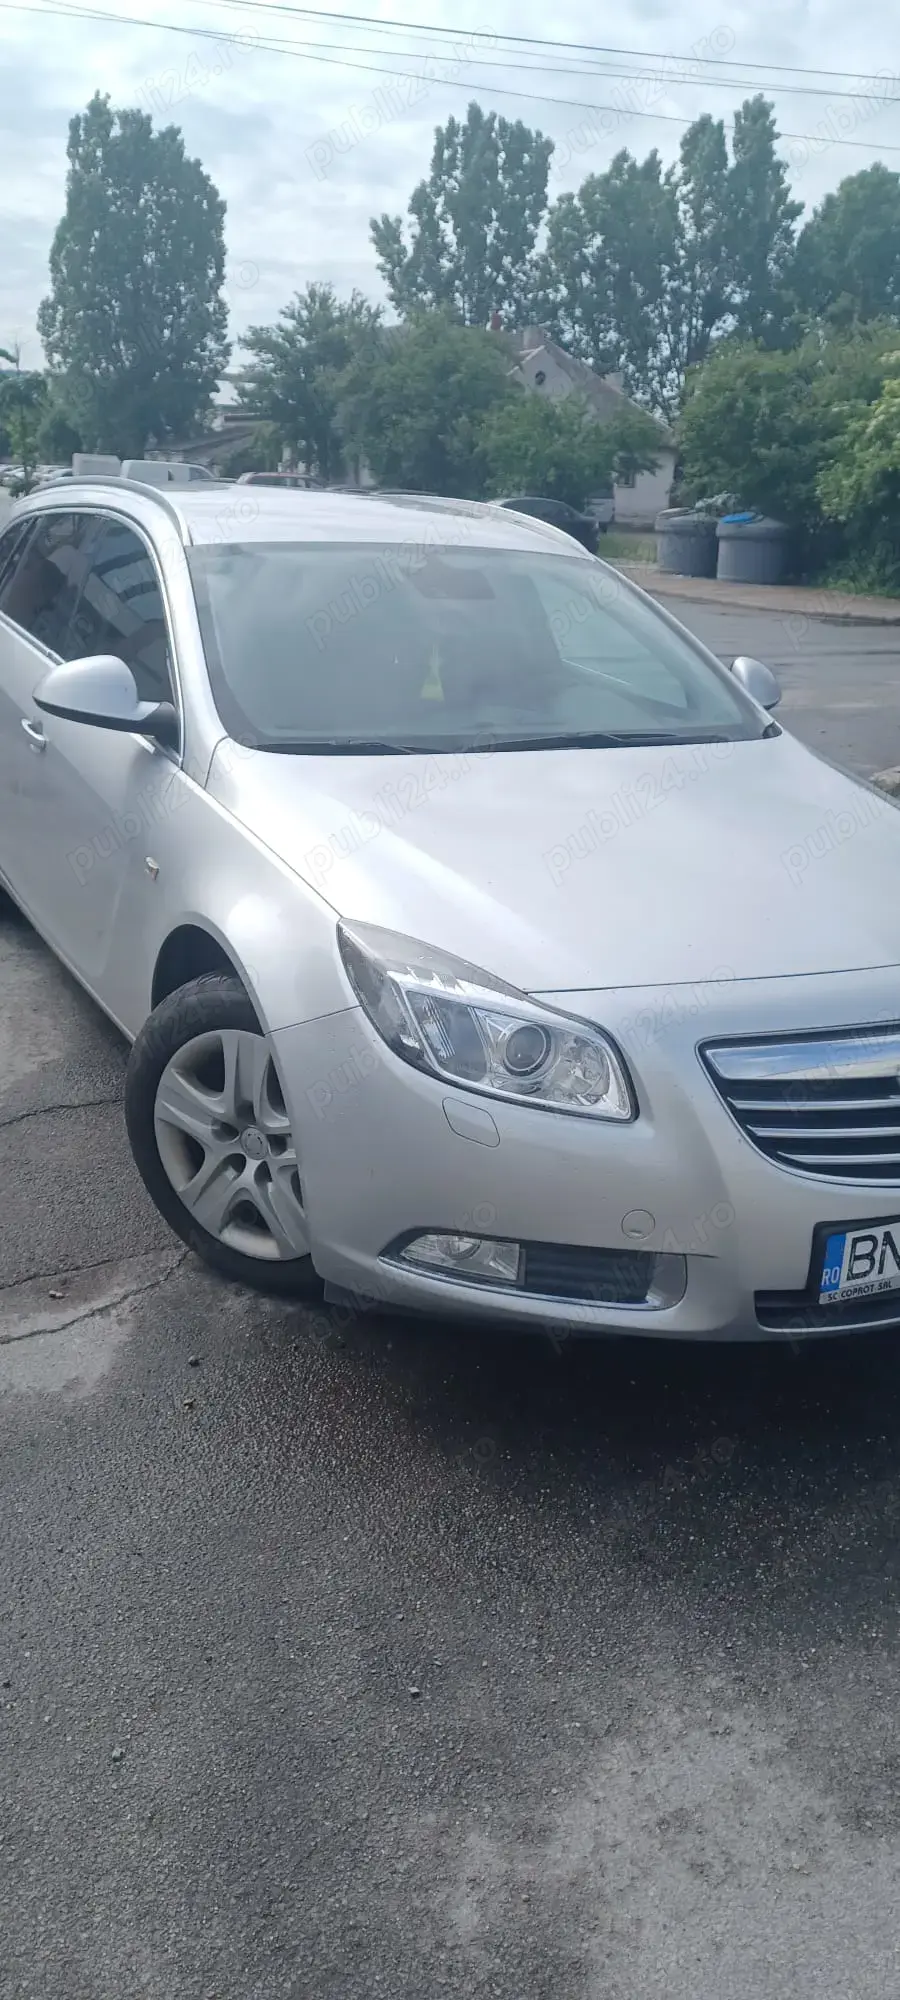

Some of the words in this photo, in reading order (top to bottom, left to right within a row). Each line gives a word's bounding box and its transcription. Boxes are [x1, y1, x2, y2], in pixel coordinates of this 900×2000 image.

[821, 1266, 840, 1287] RO
[827, 1292, 838, 1302] SC
[840, 1284, 875, 1298] COPROT
